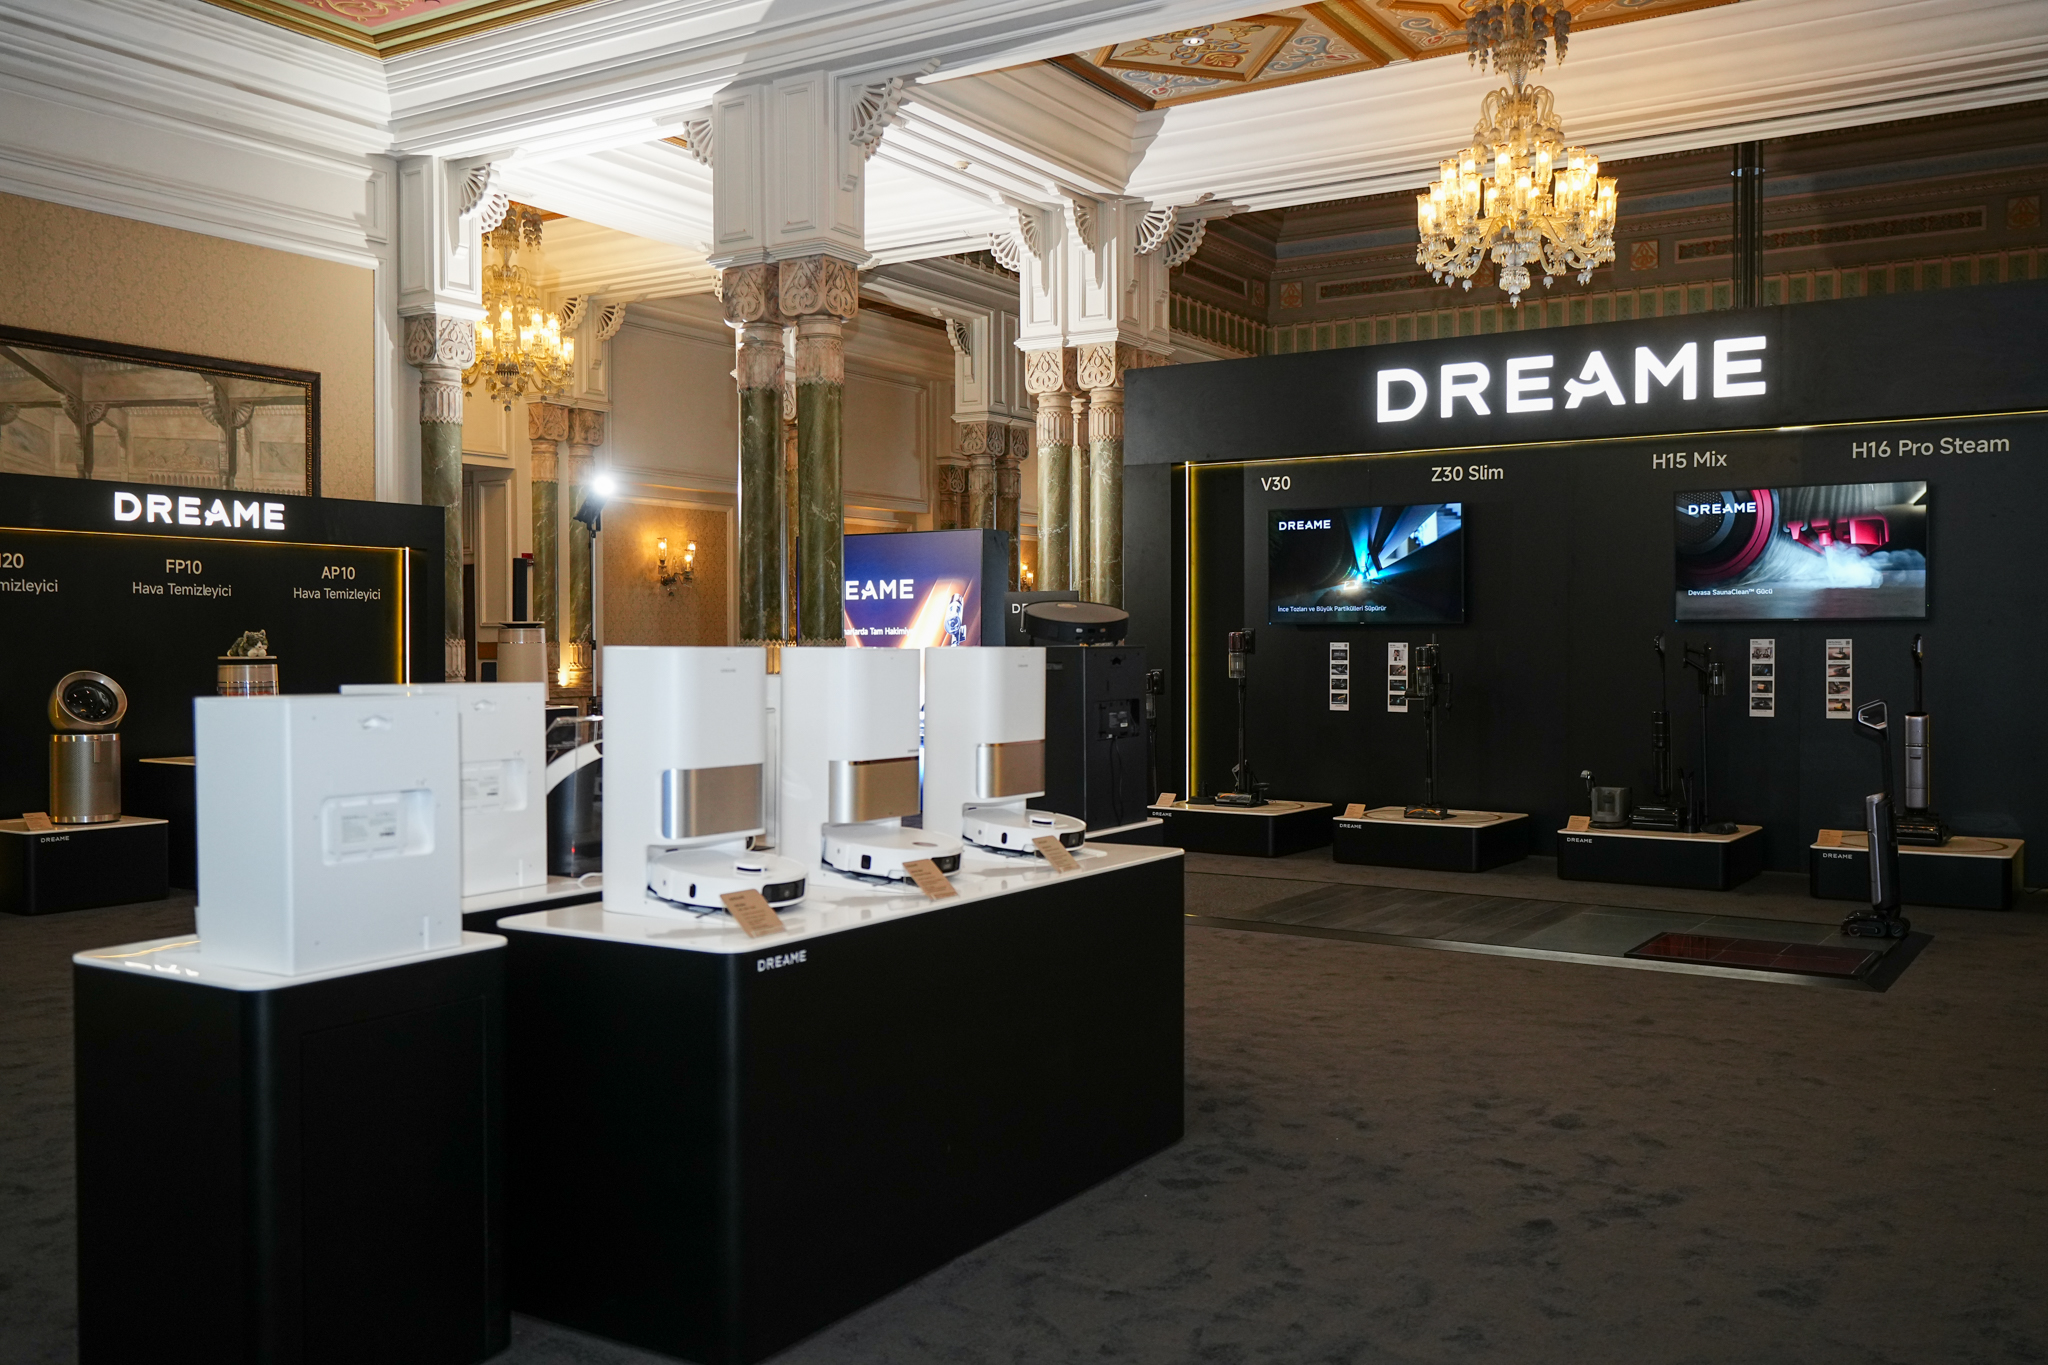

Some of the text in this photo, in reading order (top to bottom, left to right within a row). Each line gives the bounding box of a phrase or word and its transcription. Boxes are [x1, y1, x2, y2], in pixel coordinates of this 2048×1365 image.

[1376, 335, 1767, 424] DREAME
[1852, 436, 2010, 459] H16 Pro Steam
[1652, 450, 1728, 470] H15 Mix
[1431, 464, 1504, 482] Z30 Slim
[1261, 475, 1291, 492] V30
[113, 491, 286, 531] DREAME
[1687, 501, 1757, 516] DREAME
[1278, 519, 1331, 531] DREAME
[0, 552, 25, 569] 20
[165, 558, 203, 575] FP10
[321, 566, 356, 580] AP10
[132, 581, 232, 599] Hava Temizleyici
[293, 587, 381, 602] Hava Temizleyici
[1364, 605, 1387, 613] Süpürür
[869, 627, 883, 636] Tam
[41, 835, 70, 843] DREAME
[1822, 852, 1853, 860] DREAME
[757, 949, 807, 972] DREAME
